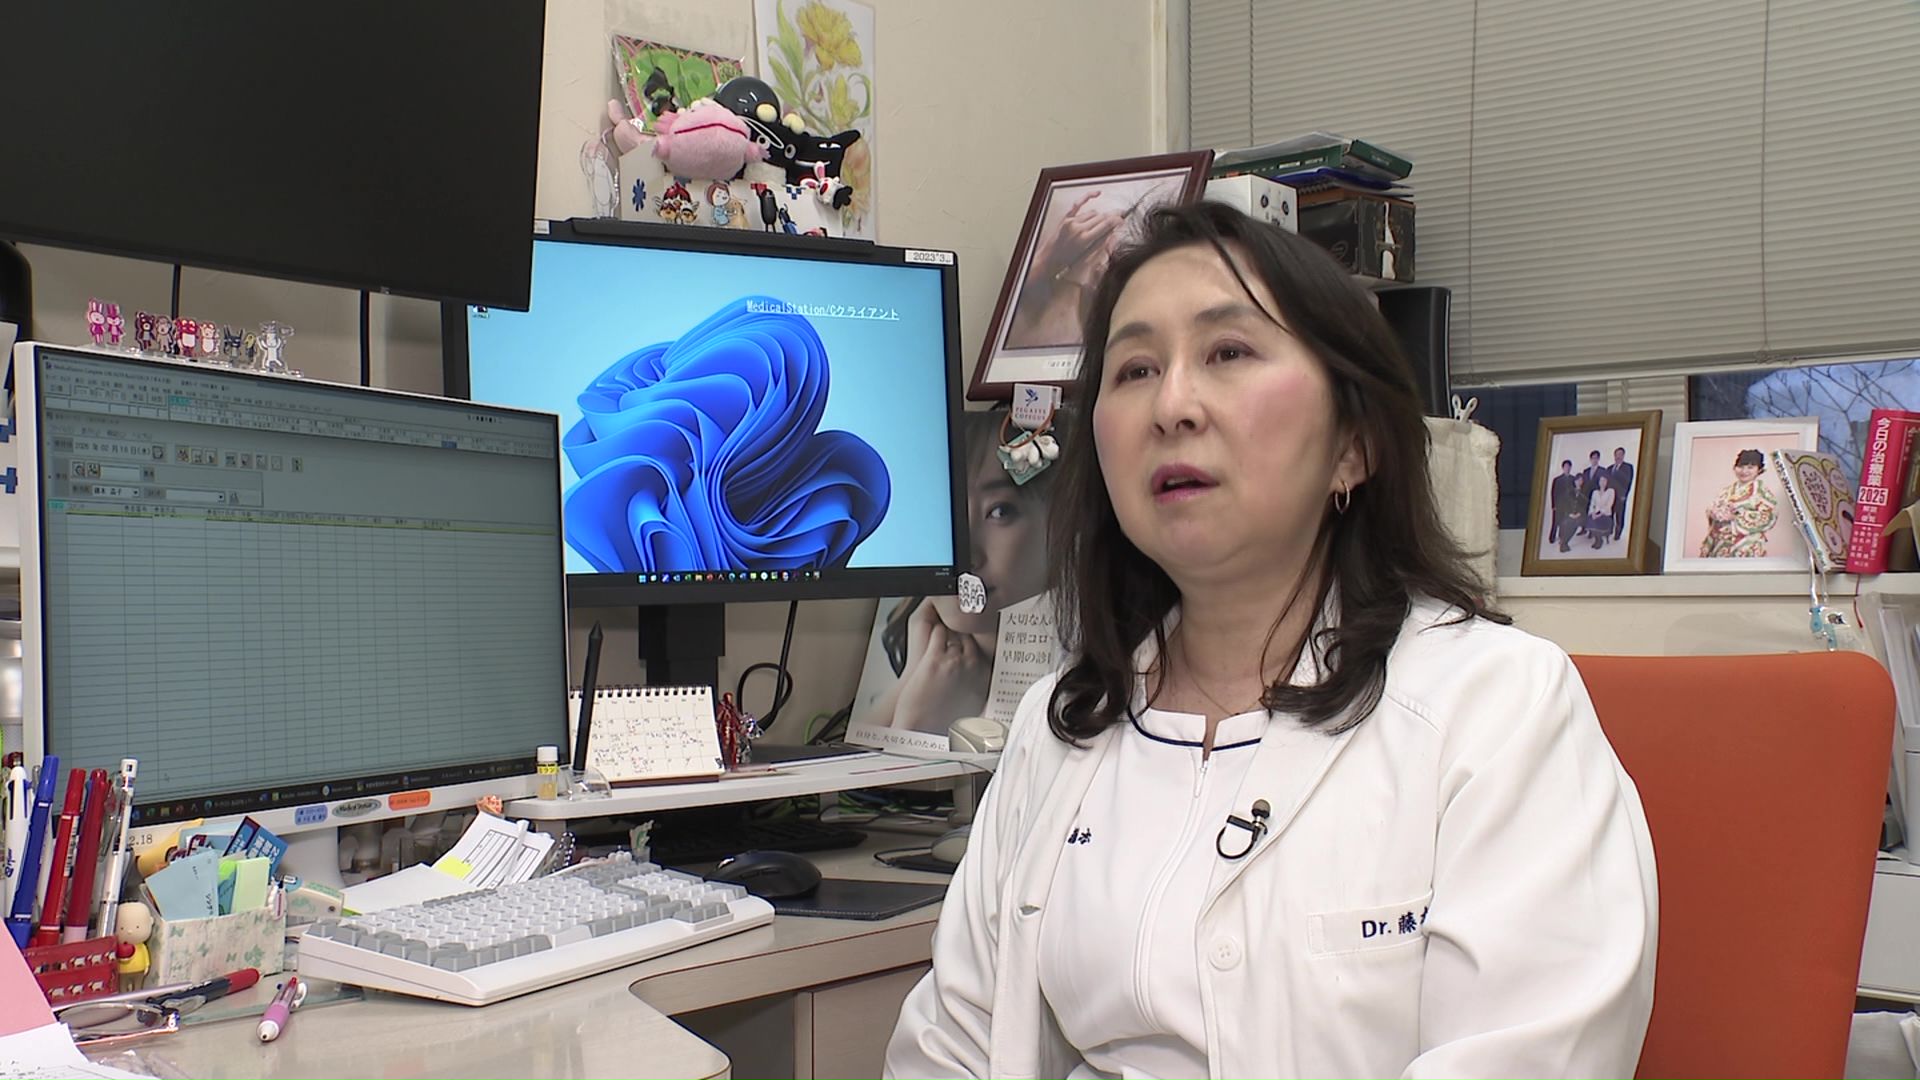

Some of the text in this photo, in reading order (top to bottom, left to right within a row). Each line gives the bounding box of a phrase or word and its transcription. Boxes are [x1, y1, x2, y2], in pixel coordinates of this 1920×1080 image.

[746, 300, 899, 319] MedicalStation/Cクライアント
[1867, 417, 1891, 487] 今日の治療薬
[1859, 488, 1887, 504] 2025
[1006, 612, 1053, 627] 大切な人
[1004, 631, 1053, 645] 新型コロ
[1361, 920, 1392, 939] Dr.
